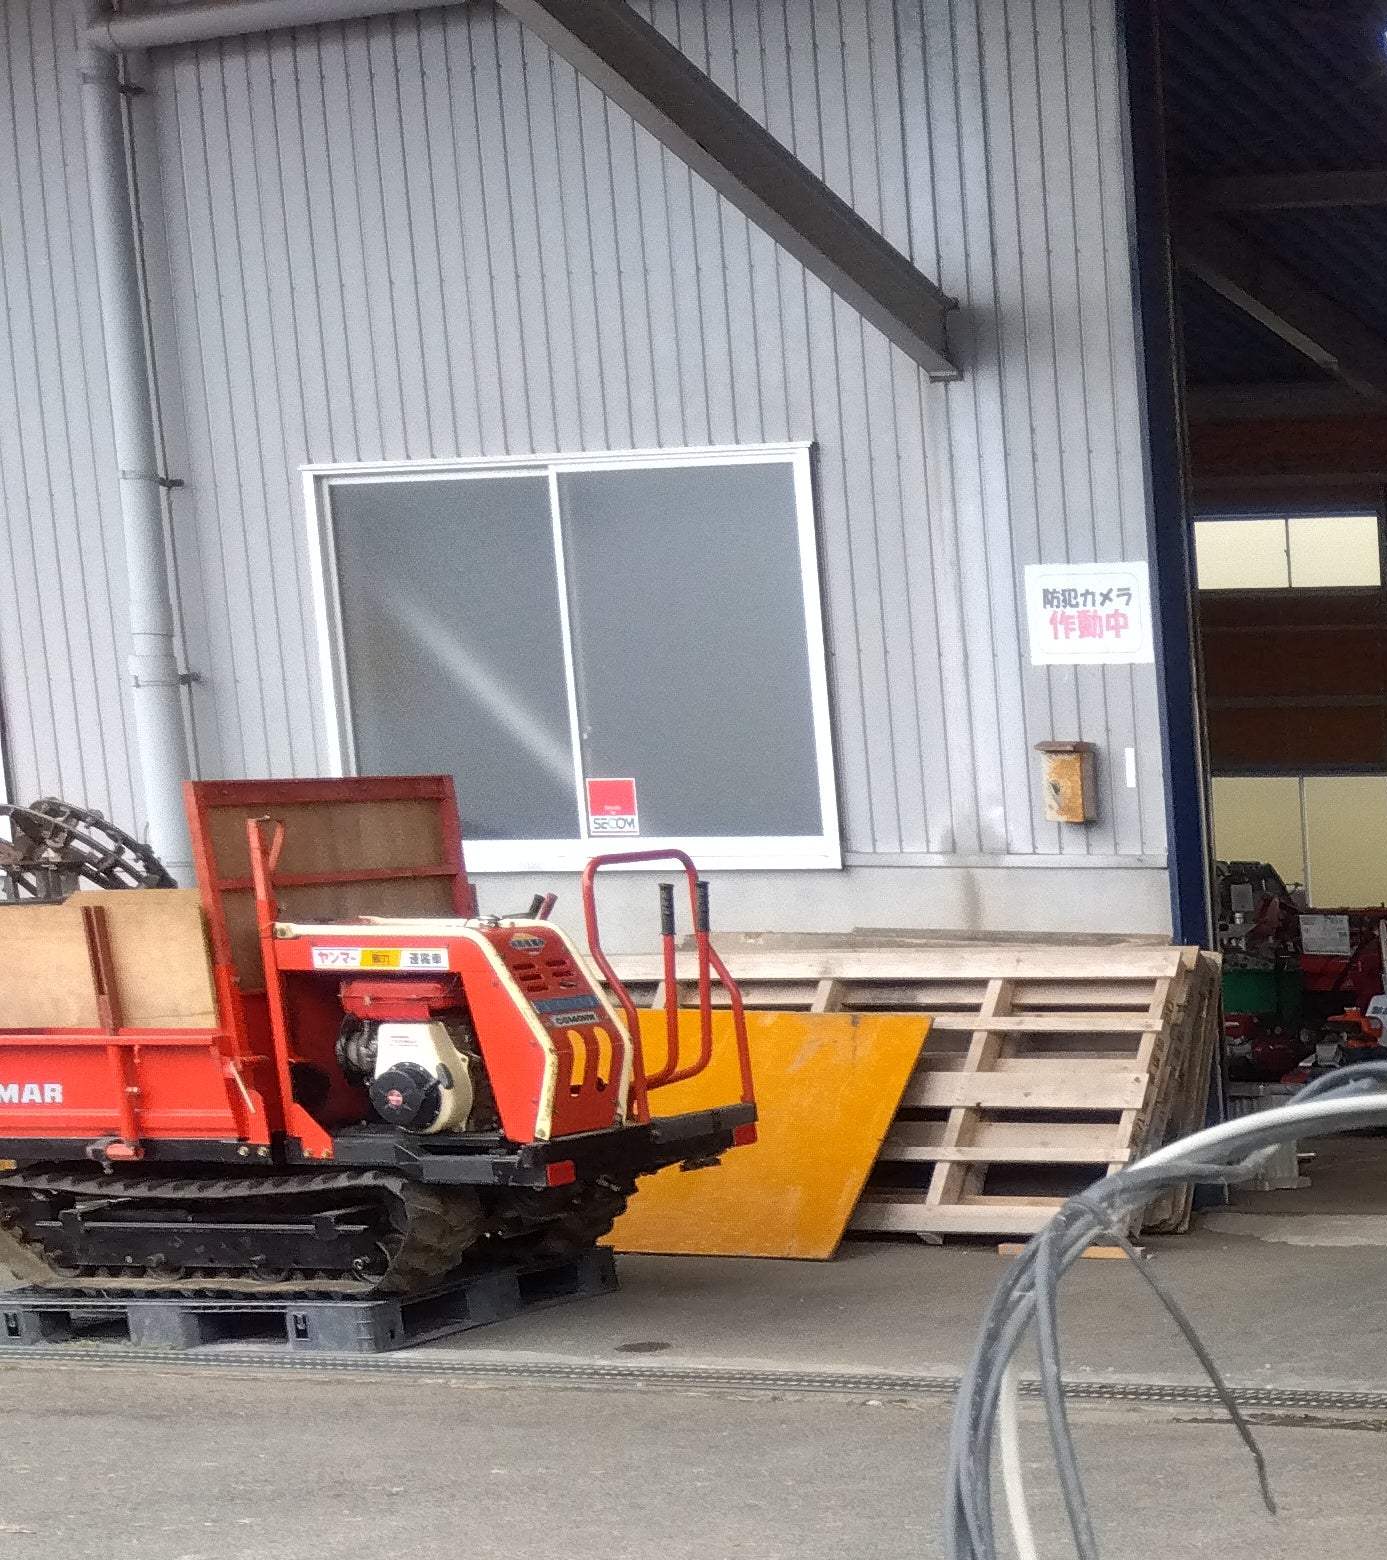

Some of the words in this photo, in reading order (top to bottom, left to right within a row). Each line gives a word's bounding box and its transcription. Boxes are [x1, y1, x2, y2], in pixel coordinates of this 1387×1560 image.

[1042, 587, 1132, 609] 防犯カメラ
[1049, 609, 1129, 640] 作動中
[593, 817, 635, 829] SECOM
[317, 951, 357, 964] ヤンマー
